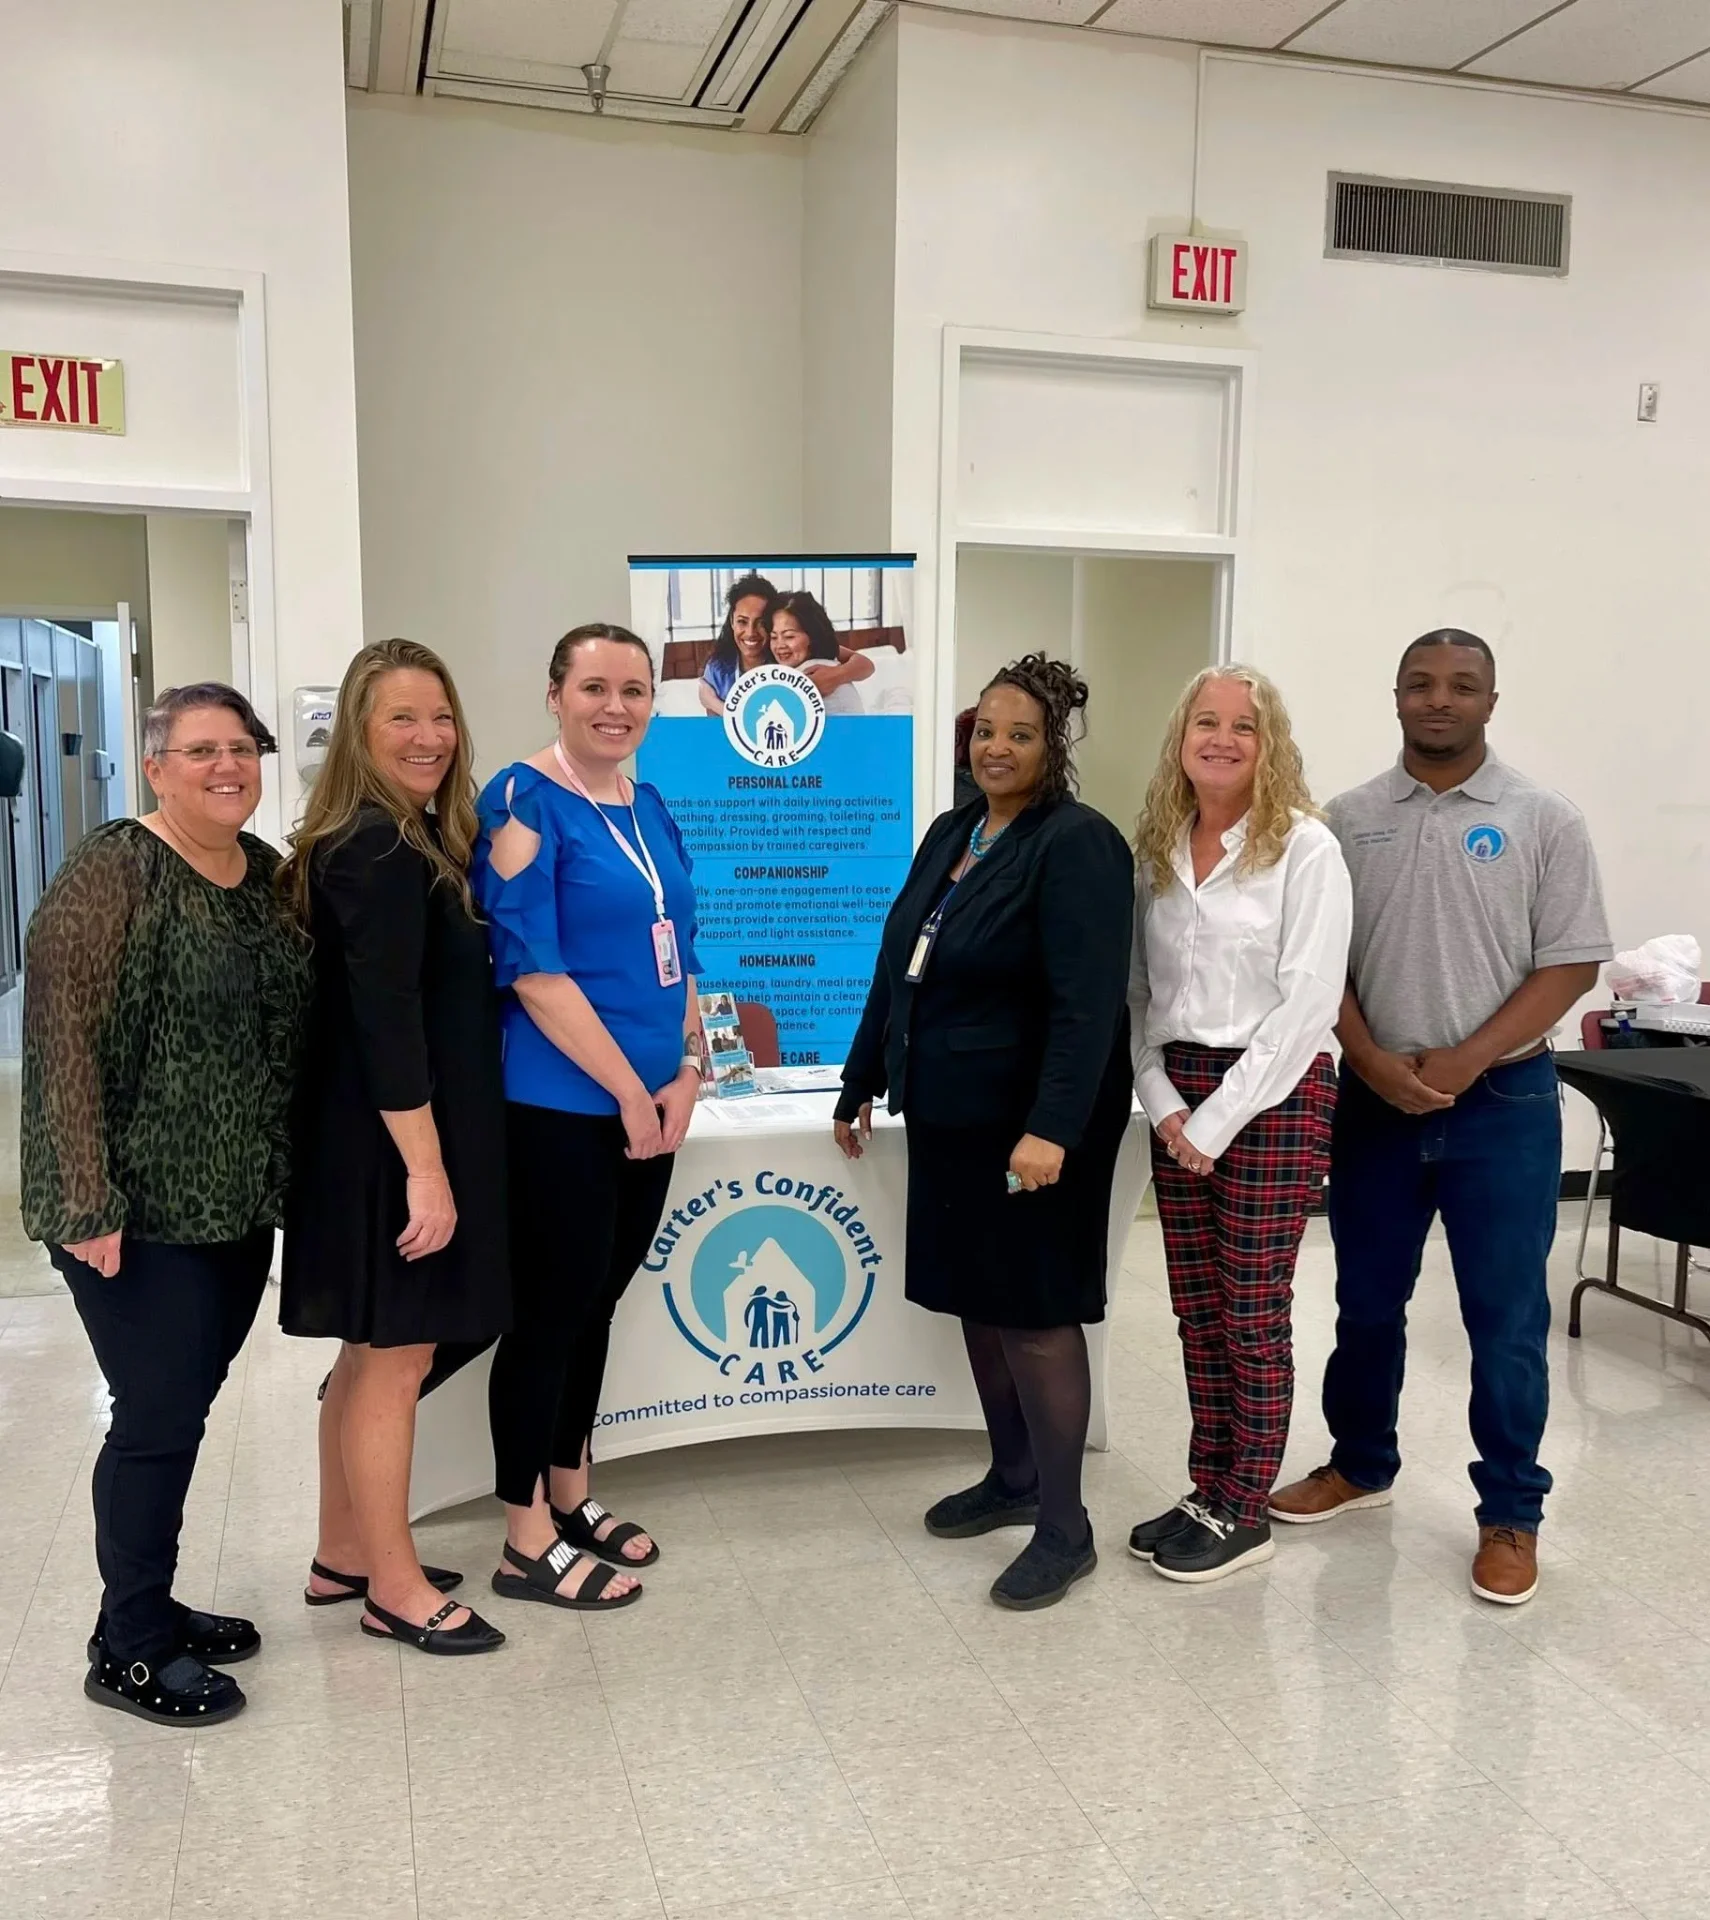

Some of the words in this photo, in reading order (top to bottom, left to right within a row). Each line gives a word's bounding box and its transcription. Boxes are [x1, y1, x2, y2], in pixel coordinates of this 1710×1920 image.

[1172, 244, 1237, 303] EXIT
[11, 356, 103, 425] EXIT
[726, 671, 767, 713] Carter's
[771, 668, 824, 714] Confident
[753, 750, 799, 766] CARE
[728, 775, 788, 789] PERSONAL
[791, 775, 823, 789] CARE
[714, 797, 755, 810] support
[758, 796, 780, 808] with
[783, 796, 810, 809] daily
[812, 795, 842, 809] living
[844, 795, 893, 807] activities
[772, 811, 828, 823] grooming,
[880, 811, 901, 821] and
[730, 825, 779, 837] Provided
[782, 825, 805, 837] with
[807, 825, 848, 838] respect
[851, 825, 871, 836] and
[684, 841, 748, 852] compassion
[751, 840, 764, 852] by
[766, 840, 805, 851] trained
[808, 840, 869, 852] caregivers.
[734, 866, 829, 880] COMPANIONSHIP
[715, 887, 778, 897] one-on-one
[781, 885, 849, 897] engagement
[852, 885, 863, 895] to
[865, 886, 891, 895] ease
[713, 900, 733, 910] and
[736, 901, 781, 913] promote
[784, 899, 839, 910] emotional
[841, 899, 892, 909] well-bein
[734, 914, 775, 926] provide
[853, 911, 885, 924] social
[747, 928, 767, 939] and
[770, 927, 795, 940] light
[796, 928, 857, 938] assistance.
[739, 954, 816, 968] HOMEMAKING
[816, 976, 844, 987] meal
[747, 992, 771, 1003] help
[773, 992, 821, 1003] maintain
[823, 993, 831, 1002] a
[832, 991, 863, 1002] clean
[776, 1007, 808, 1018] space
[810, 1005, 825, 1016] for
[790, 1052, 821, 1065] CARE
[641, 1179, 743, 1272] Carter's
[755, 1170, 883, 1269] Confident
[719, 1348, 825, 1386] CARE
[713, 1393, 734, 1408] to
[739, 1382, 890, 1405] compassionate
[895, 1384, 937, 1396] care
